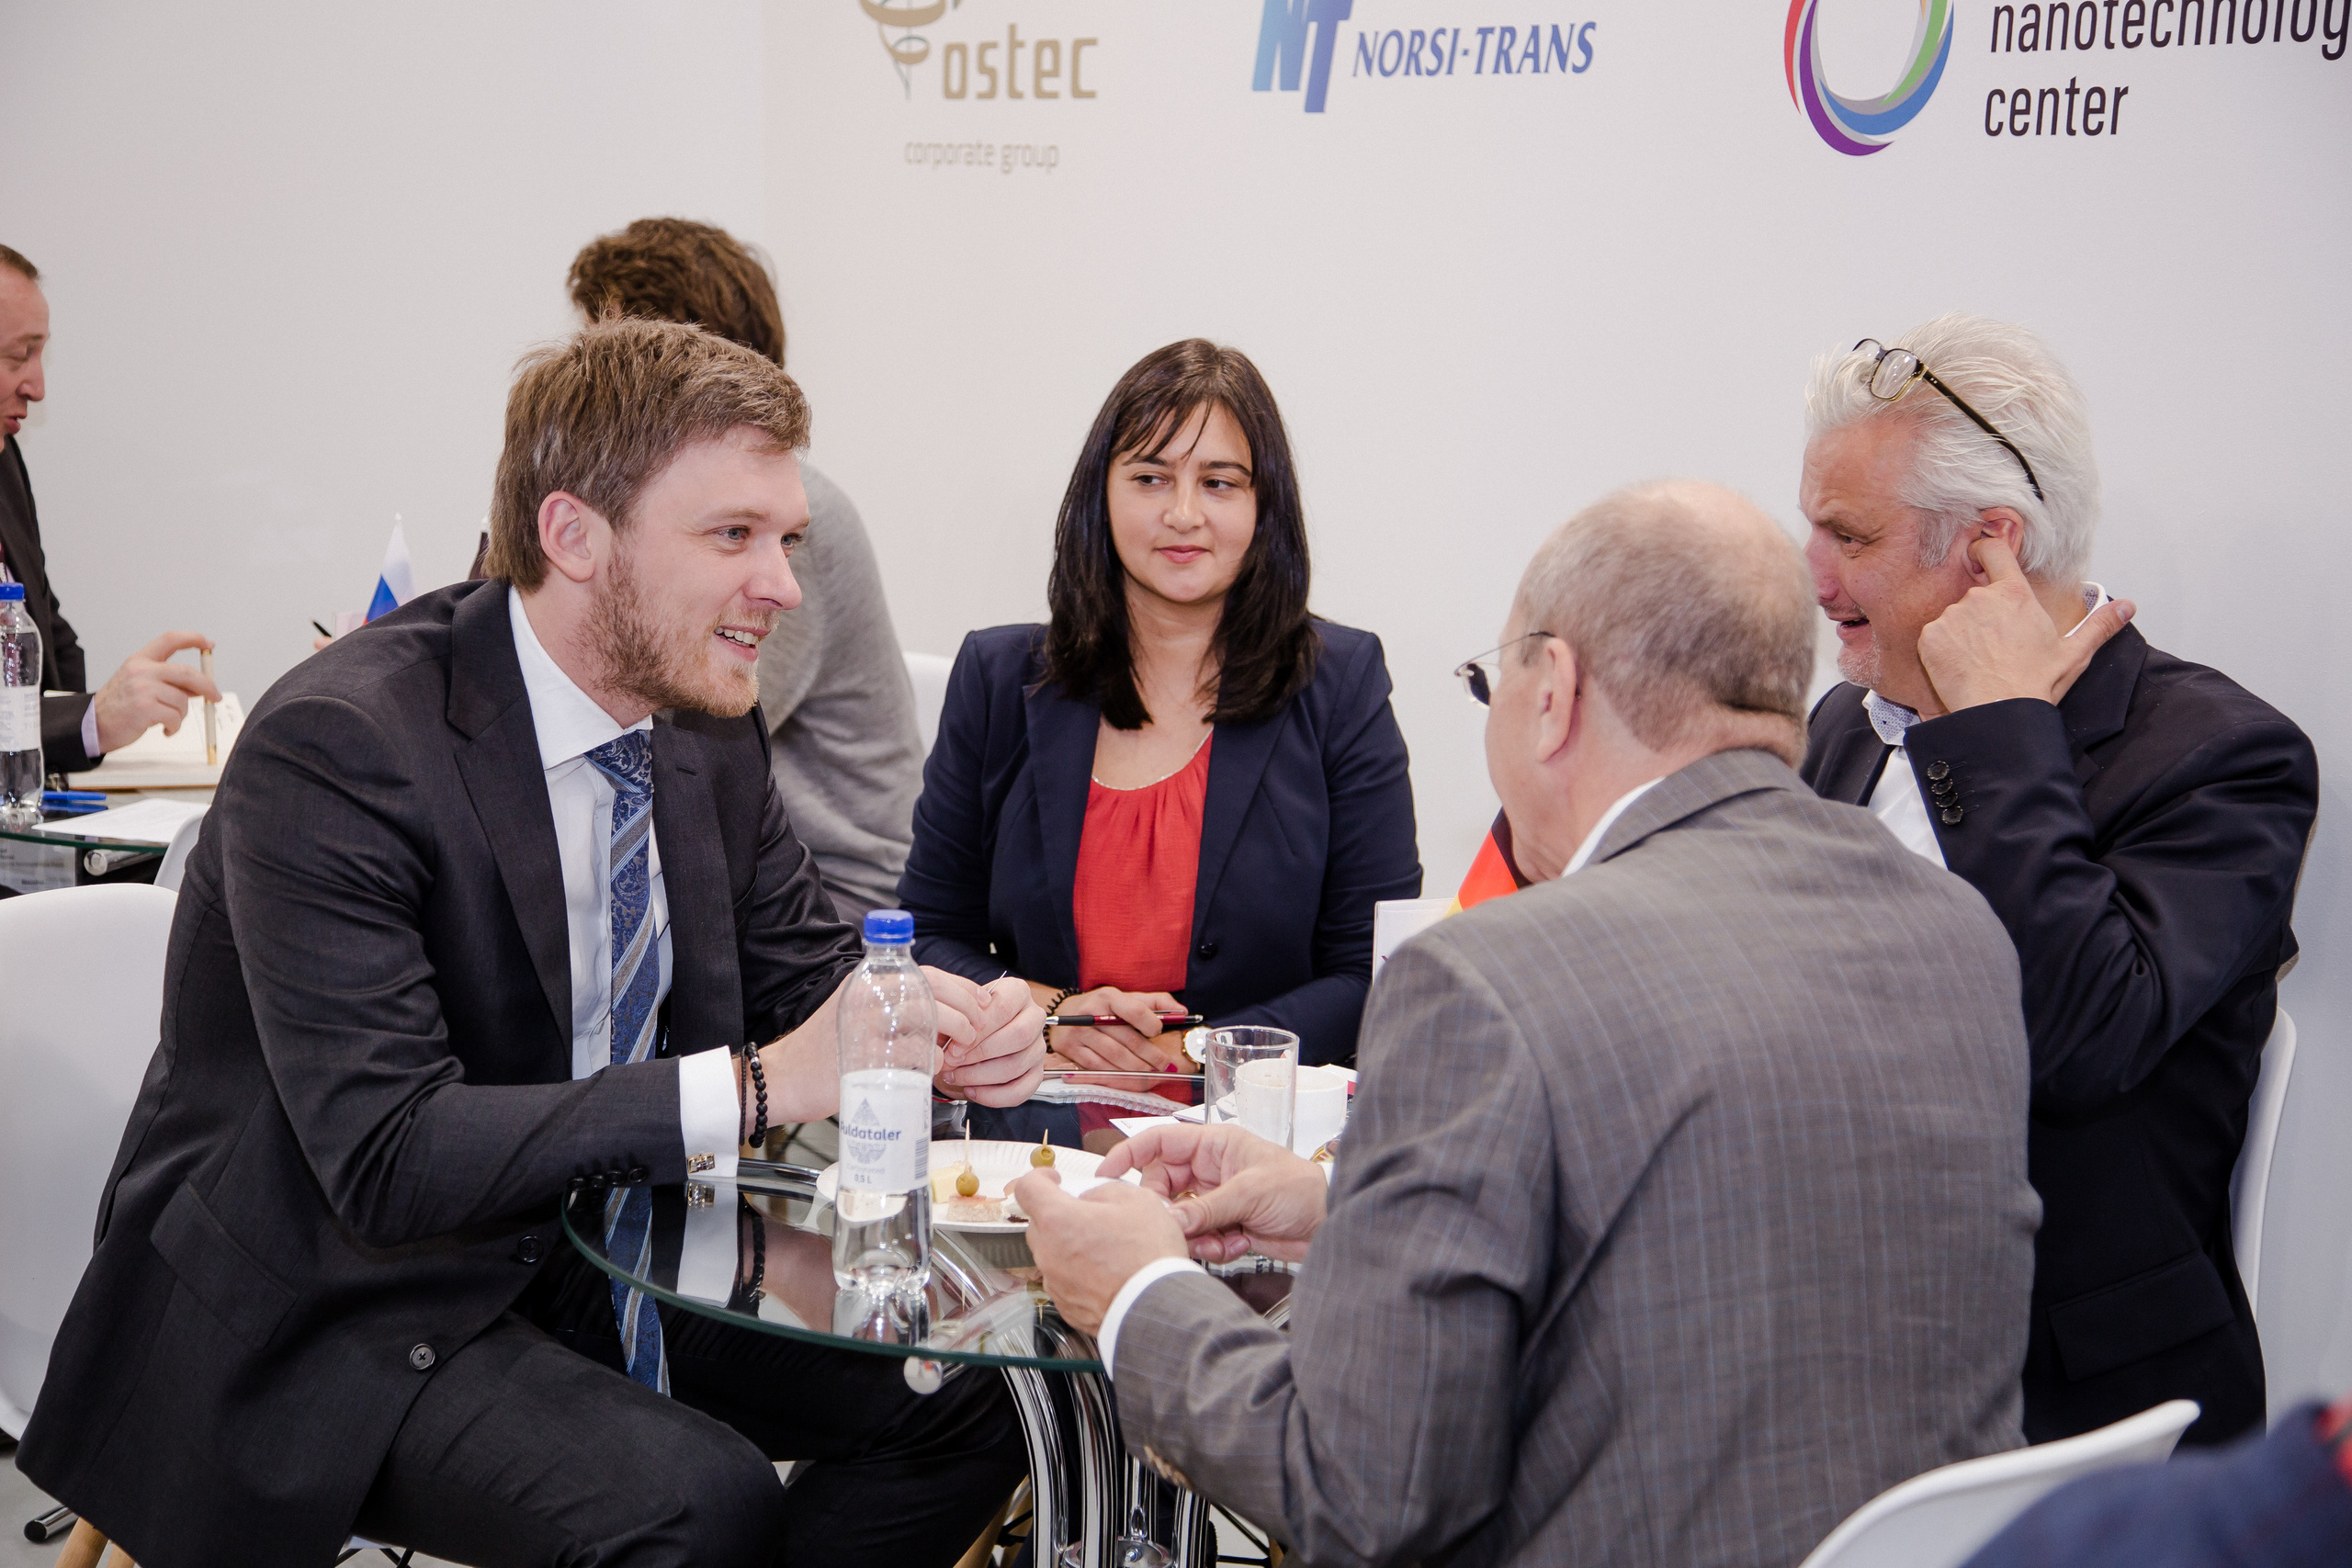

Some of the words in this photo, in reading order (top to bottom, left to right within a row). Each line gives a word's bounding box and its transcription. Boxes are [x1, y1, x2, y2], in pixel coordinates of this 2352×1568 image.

[944, 23, 1098, 99] ostec
[1984, 76, 2129, 136] center
[905, 141, 995, 170] corporate
[1001, 143, 1059, 174] group
